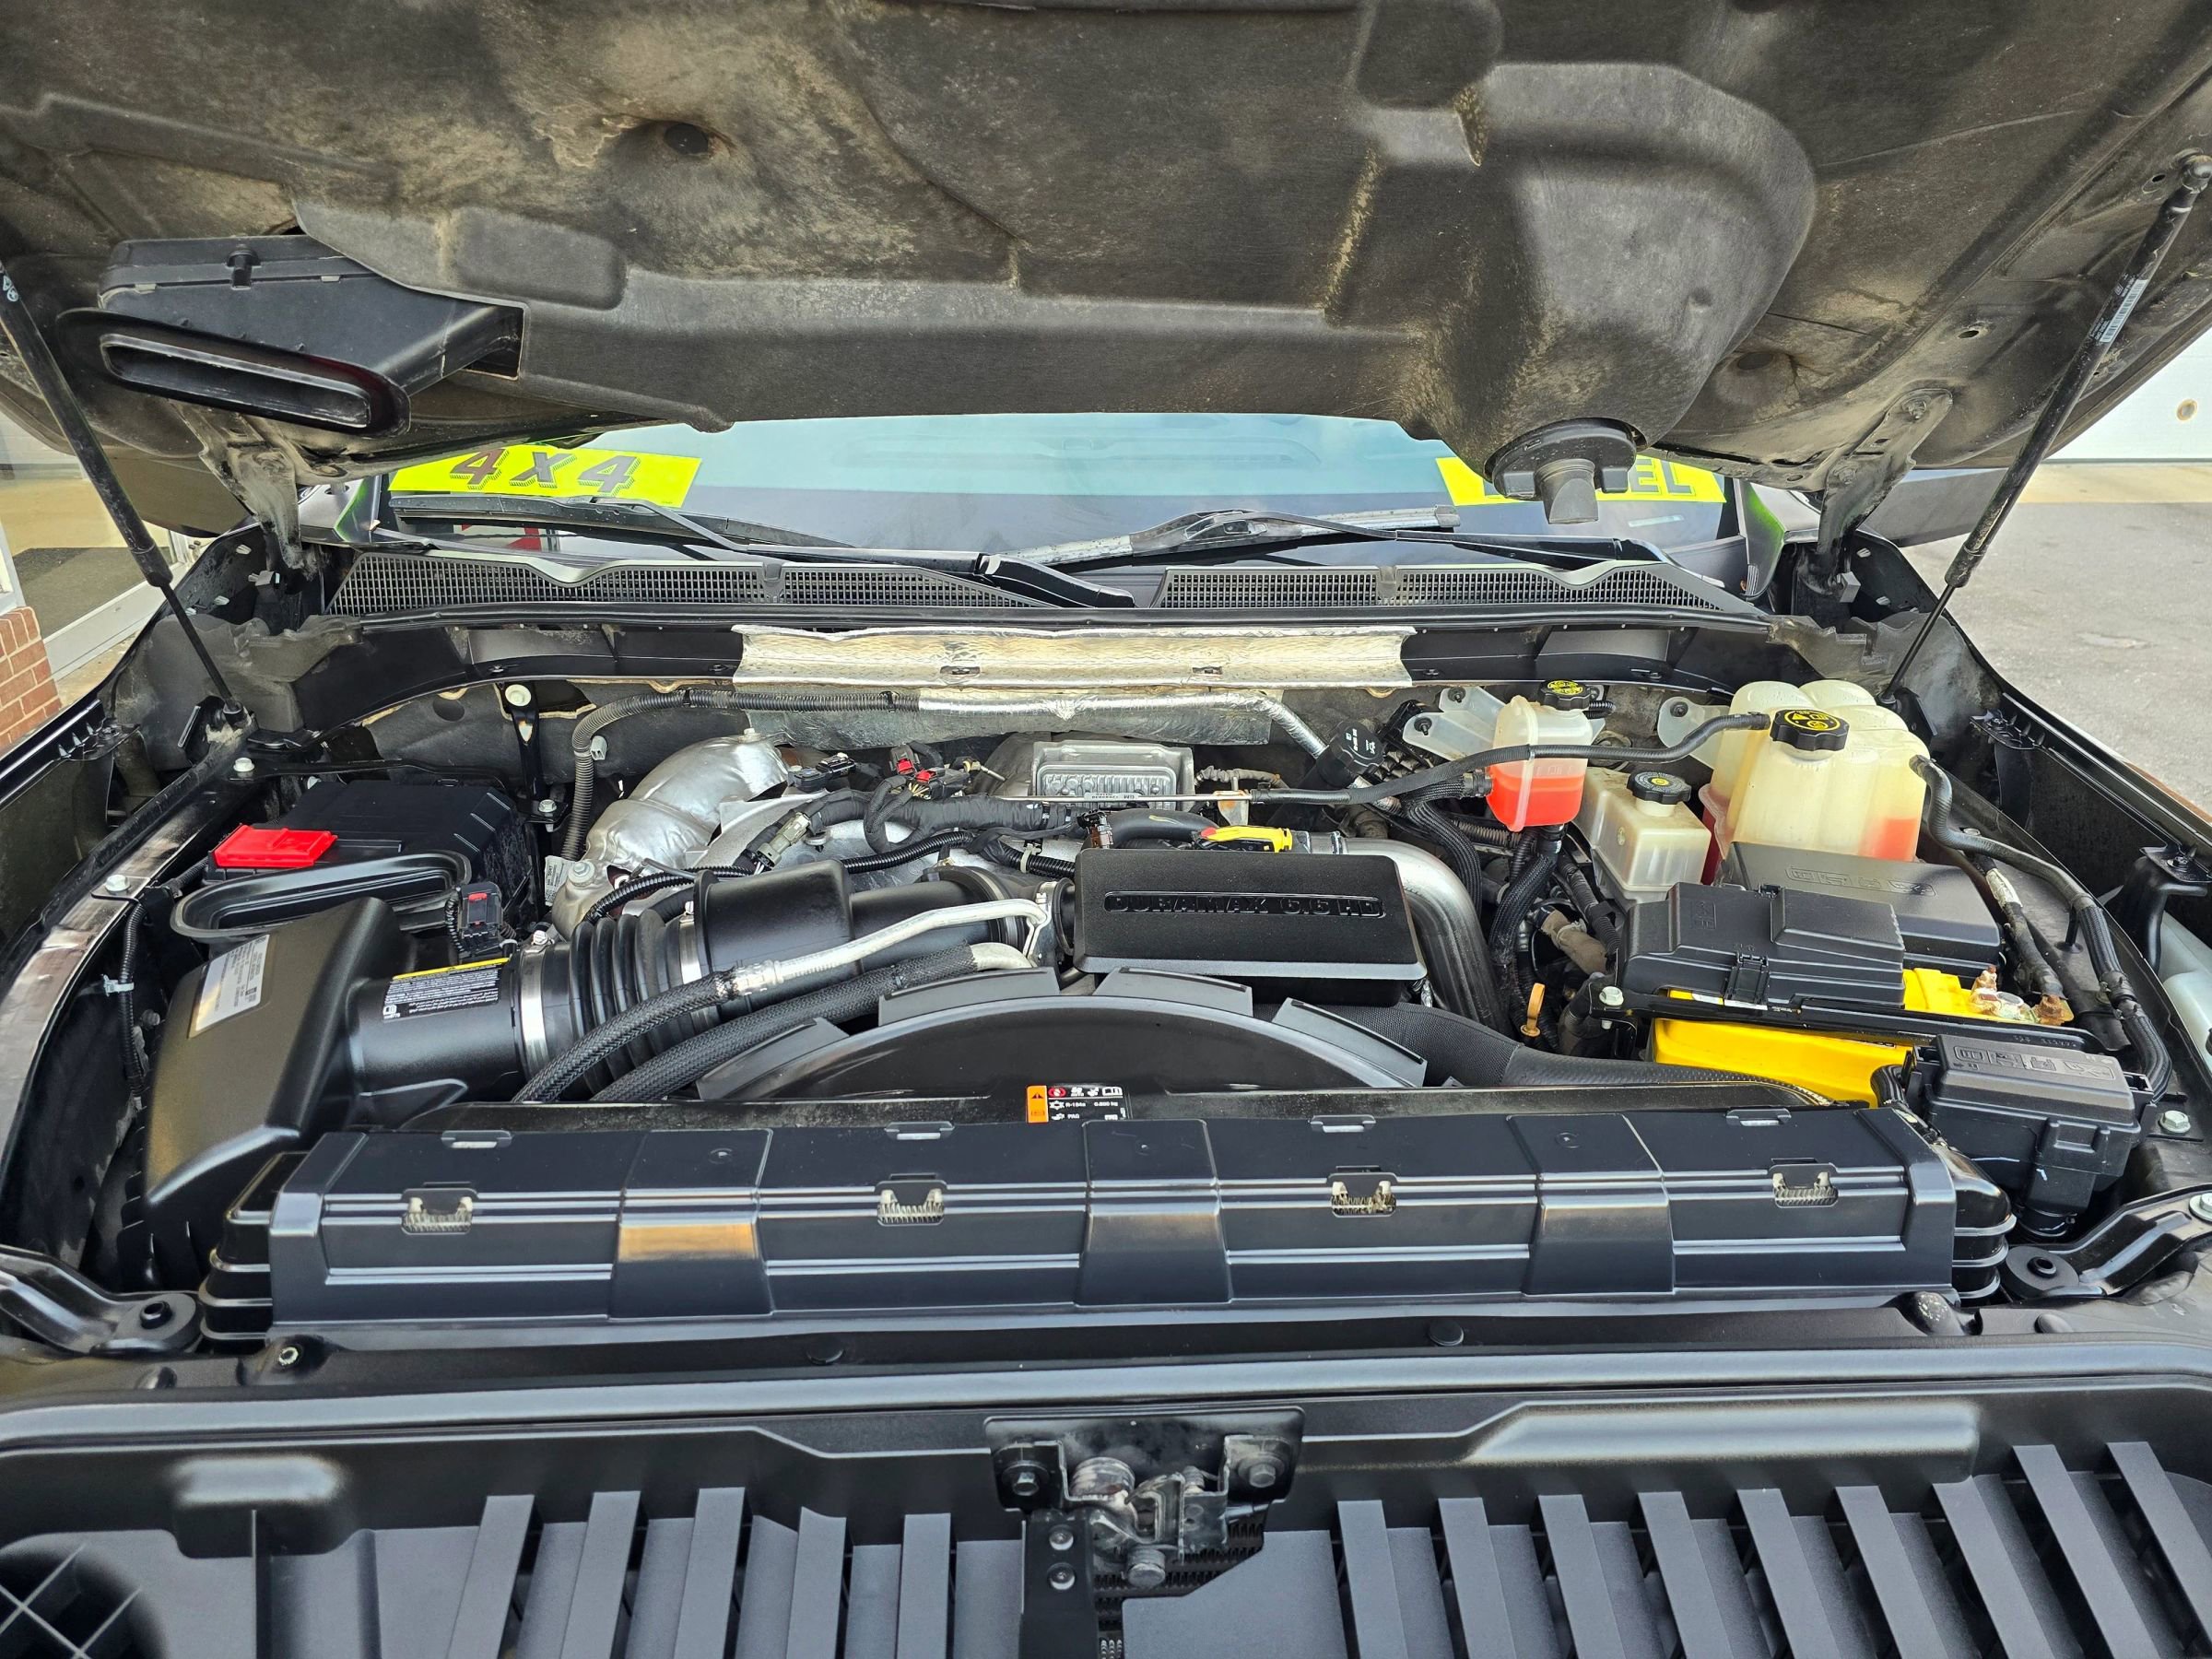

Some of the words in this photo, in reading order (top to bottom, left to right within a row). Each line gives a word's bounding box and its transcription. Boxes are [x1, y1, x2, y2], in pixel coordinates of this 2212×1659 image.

[1108, 894, 1269, 913] DURAMAX
[1279, 896, 1331, 915] 6.6
[1336, 898, 1382, 917] HD
